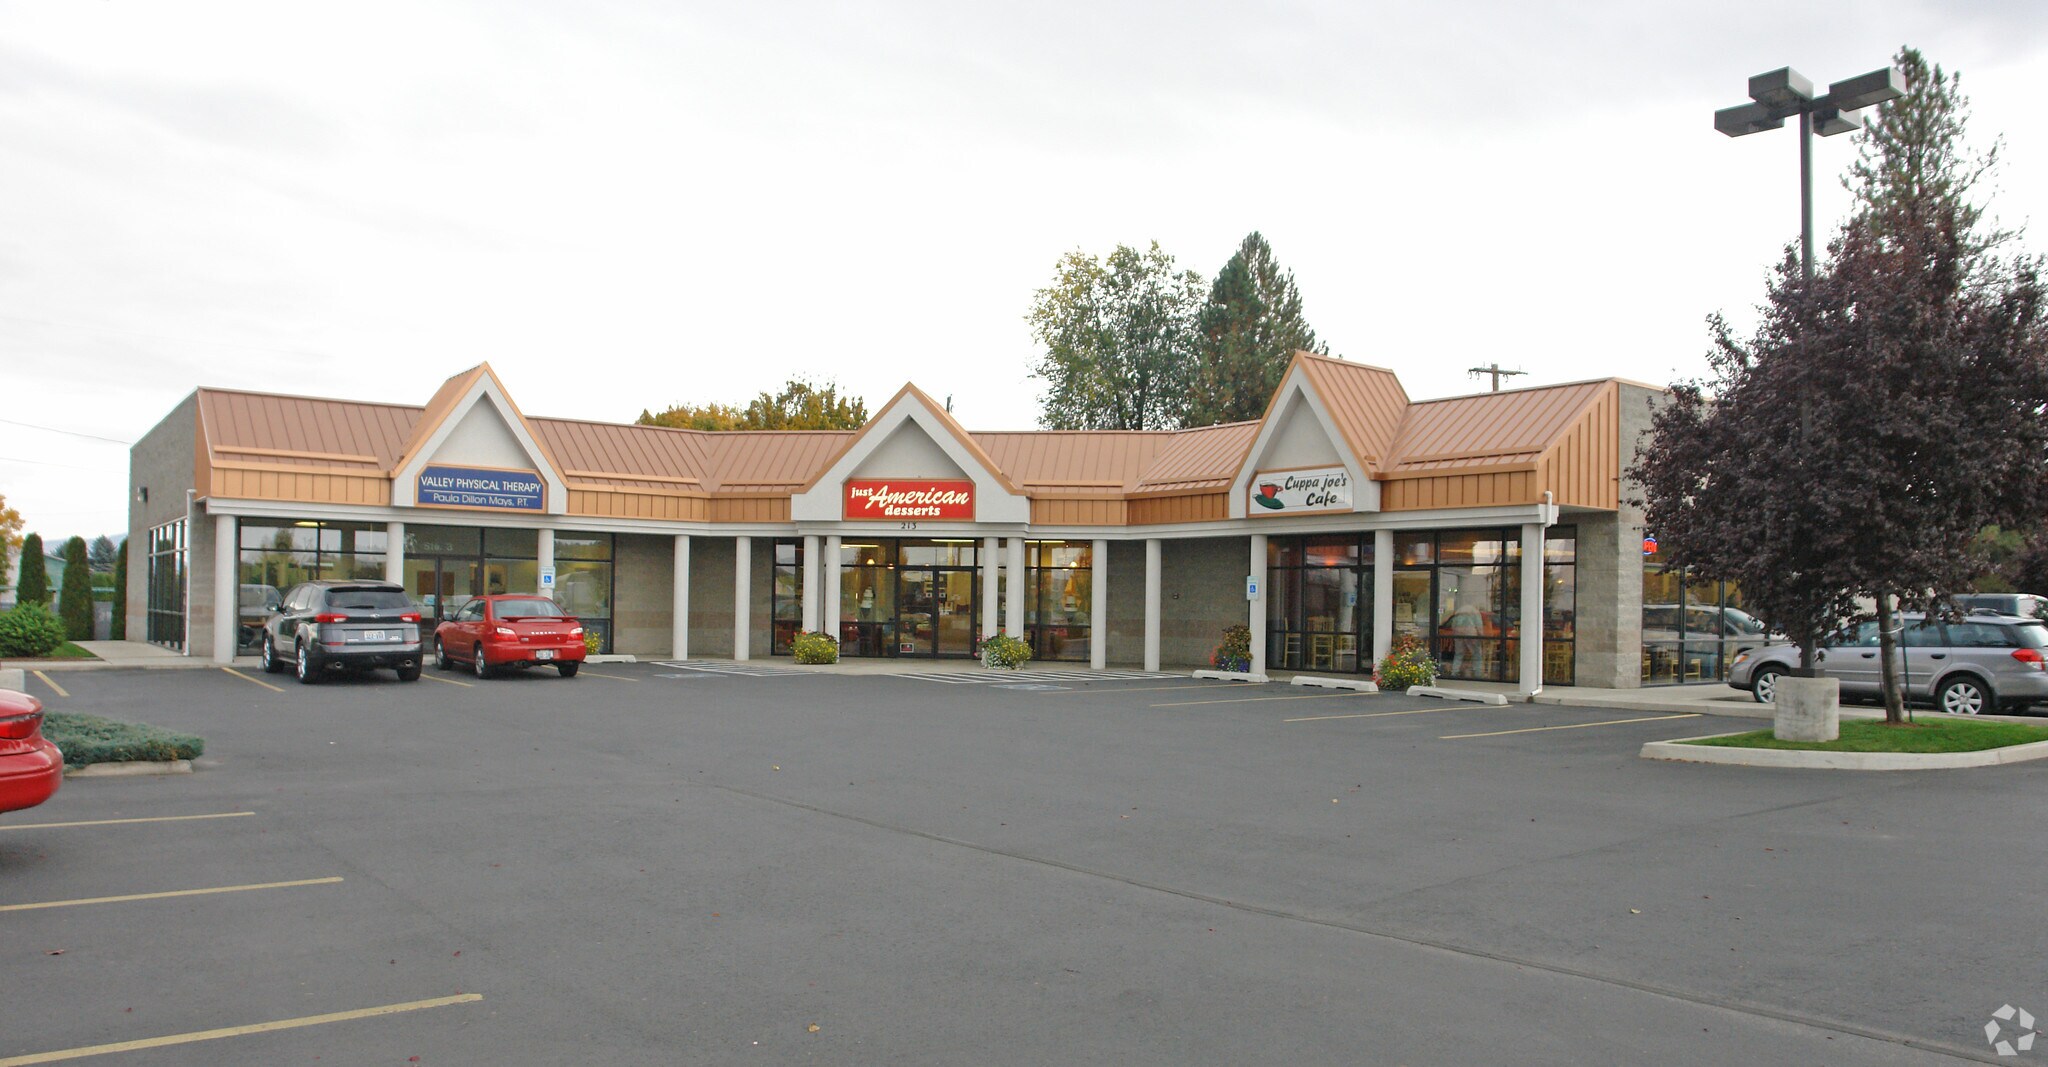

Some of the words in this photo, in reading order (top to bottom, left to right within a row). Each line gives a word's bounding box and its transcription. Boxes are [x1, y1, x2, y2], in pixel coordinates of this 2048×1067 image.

[421, 476, 454, 488] VALLEY
[456, 478, 500, 490] PHYSICAL
[502, 481, 541, 493] THERAPY
[1285, 475, 1319, 491] Cuppa
[1321, 473, 1347, 492] joe's
[433, 493, 459, 503] Paula
[462, 494, 487, 504] Dillon
[851, 487, 873, 498] just
[865, 485, 969, 509] American
[1306, 491, 1337, 506] Cafe
[885, 505, 940, 516] desserts
[901, 522, 917, 530] 213
